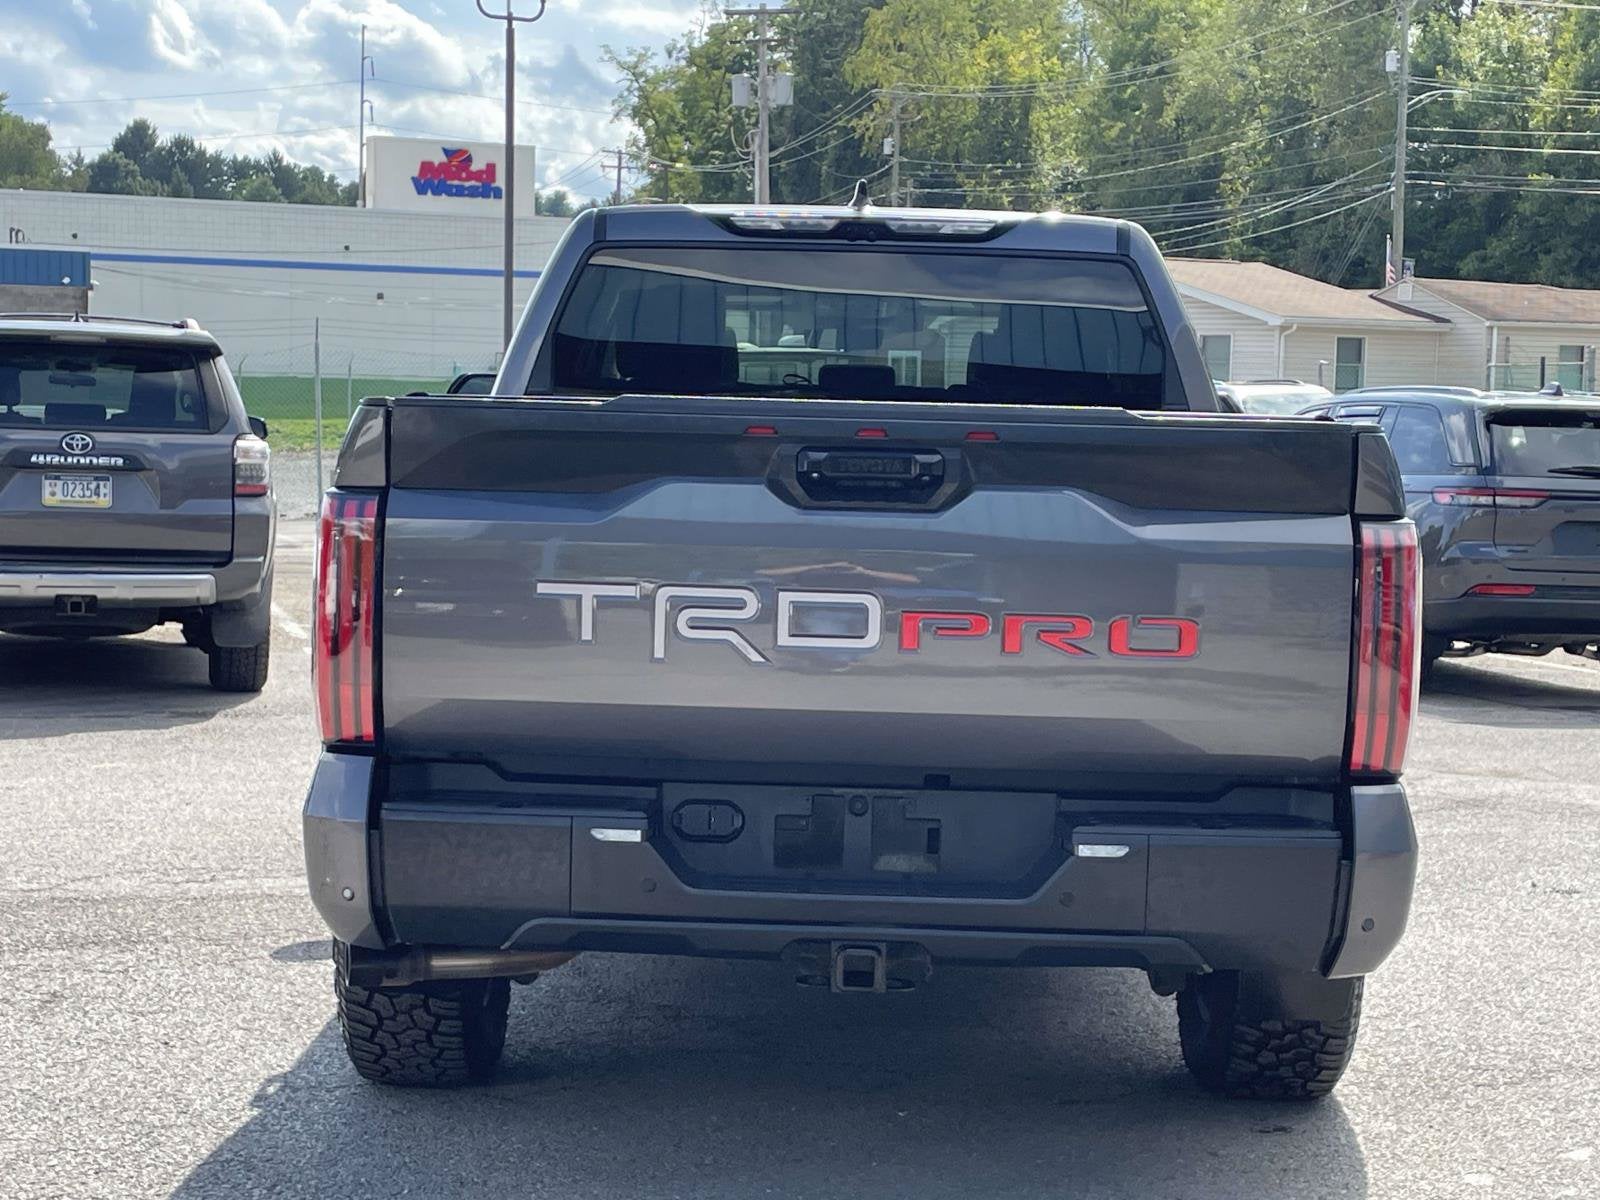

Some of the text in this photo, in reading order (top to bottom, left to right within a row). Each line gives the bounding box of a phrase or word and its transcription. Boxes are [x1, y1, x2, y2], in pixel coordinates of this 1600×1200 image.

[418, 161, 496, 183] Mod
[411, 176, 503, 199] Wash
[837, 457, 906, 473] TOYOTA
[62, 481, 101, 499] 02354
[536, 580, 1200, 664] TRD PRO
